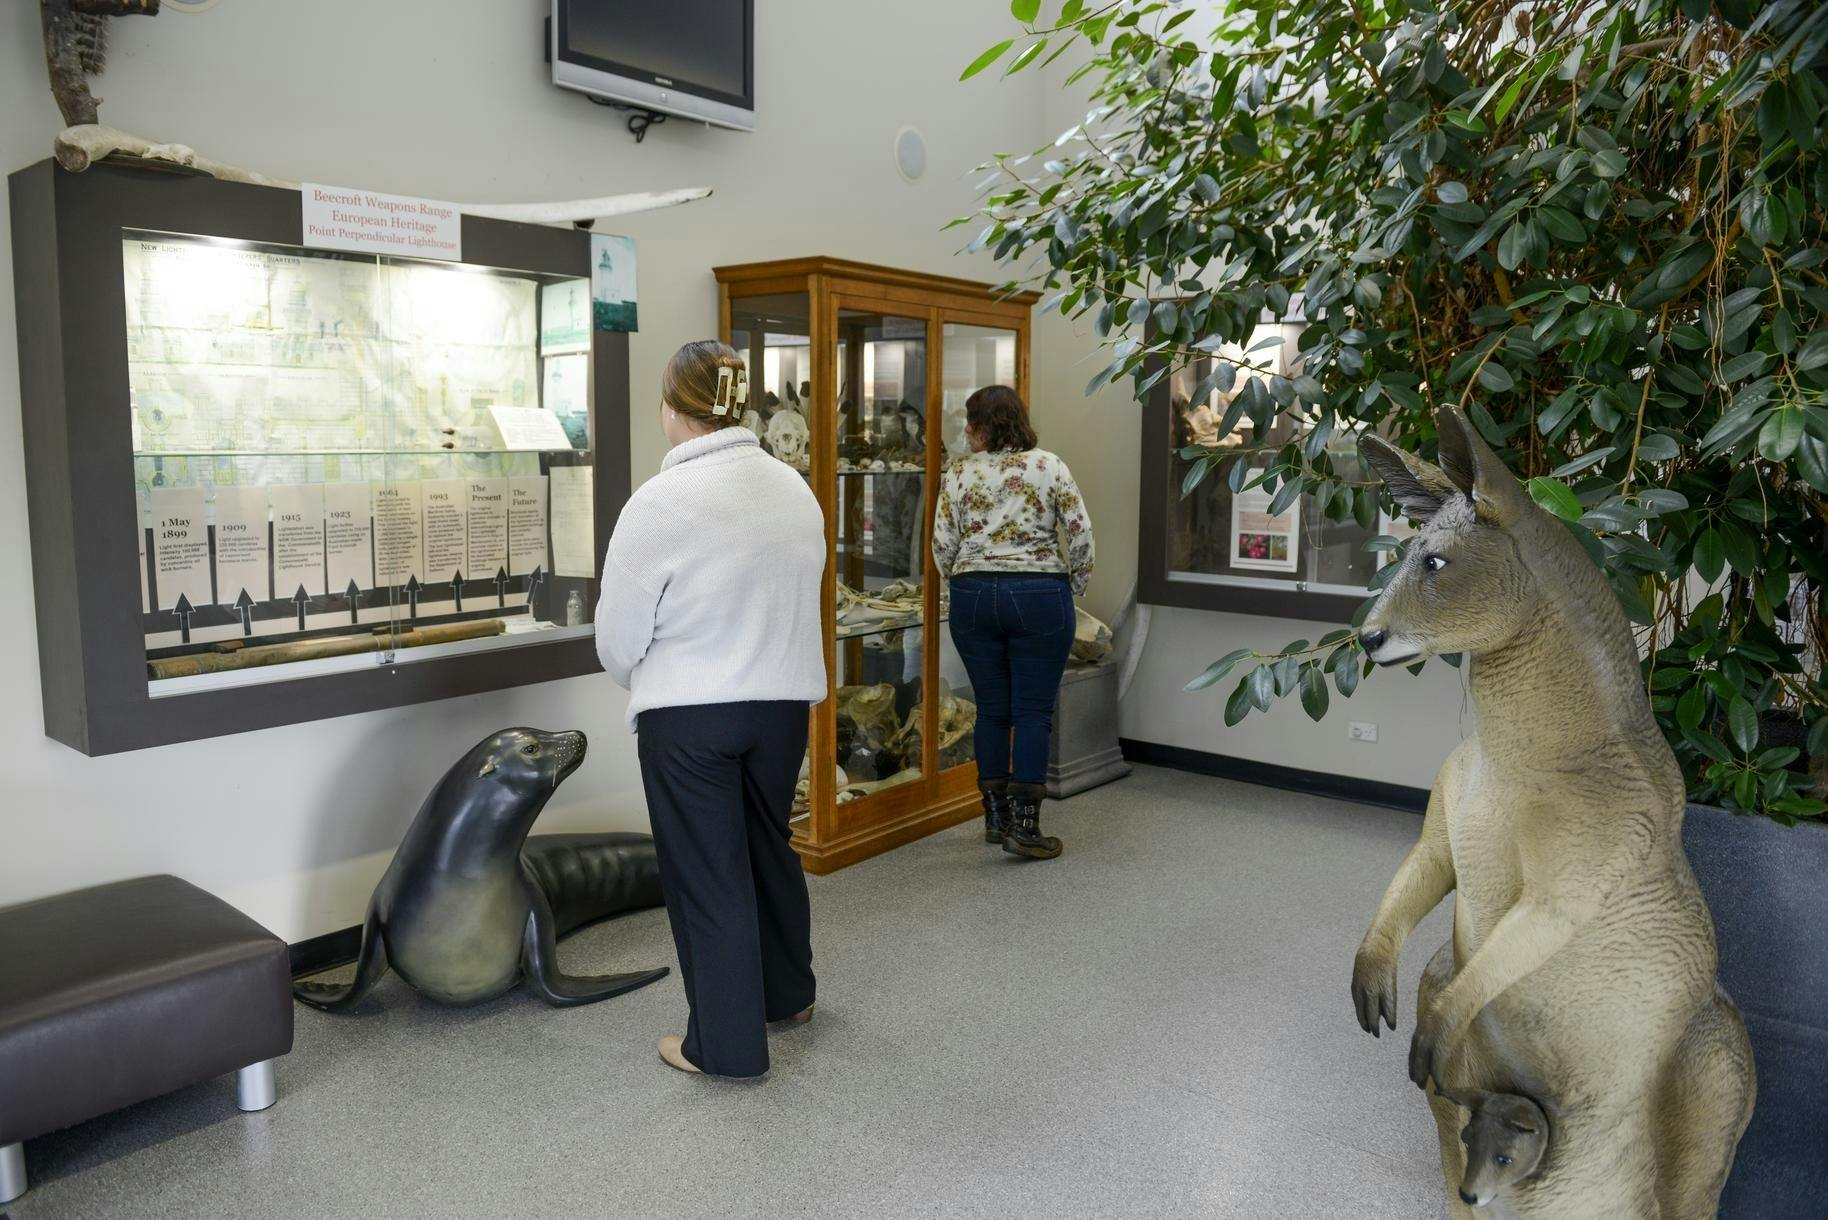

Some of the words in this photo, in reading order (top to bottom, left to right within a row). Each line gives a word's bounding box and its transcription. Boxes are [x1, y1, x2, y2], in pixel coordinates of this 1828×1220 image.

[314, 189, 361, 207] Beecroft
[365, 195, 417, 214] Weapons
[420, 202, 454, 220] Range
[332, 209, 387, 229] European
[391, 216, 438, 235] Heritage
[309, 224, 336, 238] Point
[339, 229, 406, 247] Perpendicular
[409, 236, 457, 252] Lighthouse
[141, 243, 158, 251] NEW
[472, 484, 487, 492] The
[429, 493, 449, 501] 1993
[513, 489, 527, 497] The
[472, 494, 503, 502] Present
[513, 498, 538, 506] Future
[281, 514, 302, 522] 1915
[331, 511, 352, 520] 1923
[169, 518, 192, 528] May
[223, 524, 247, 532] 1909
[163, 530, 187, 539] 1899
